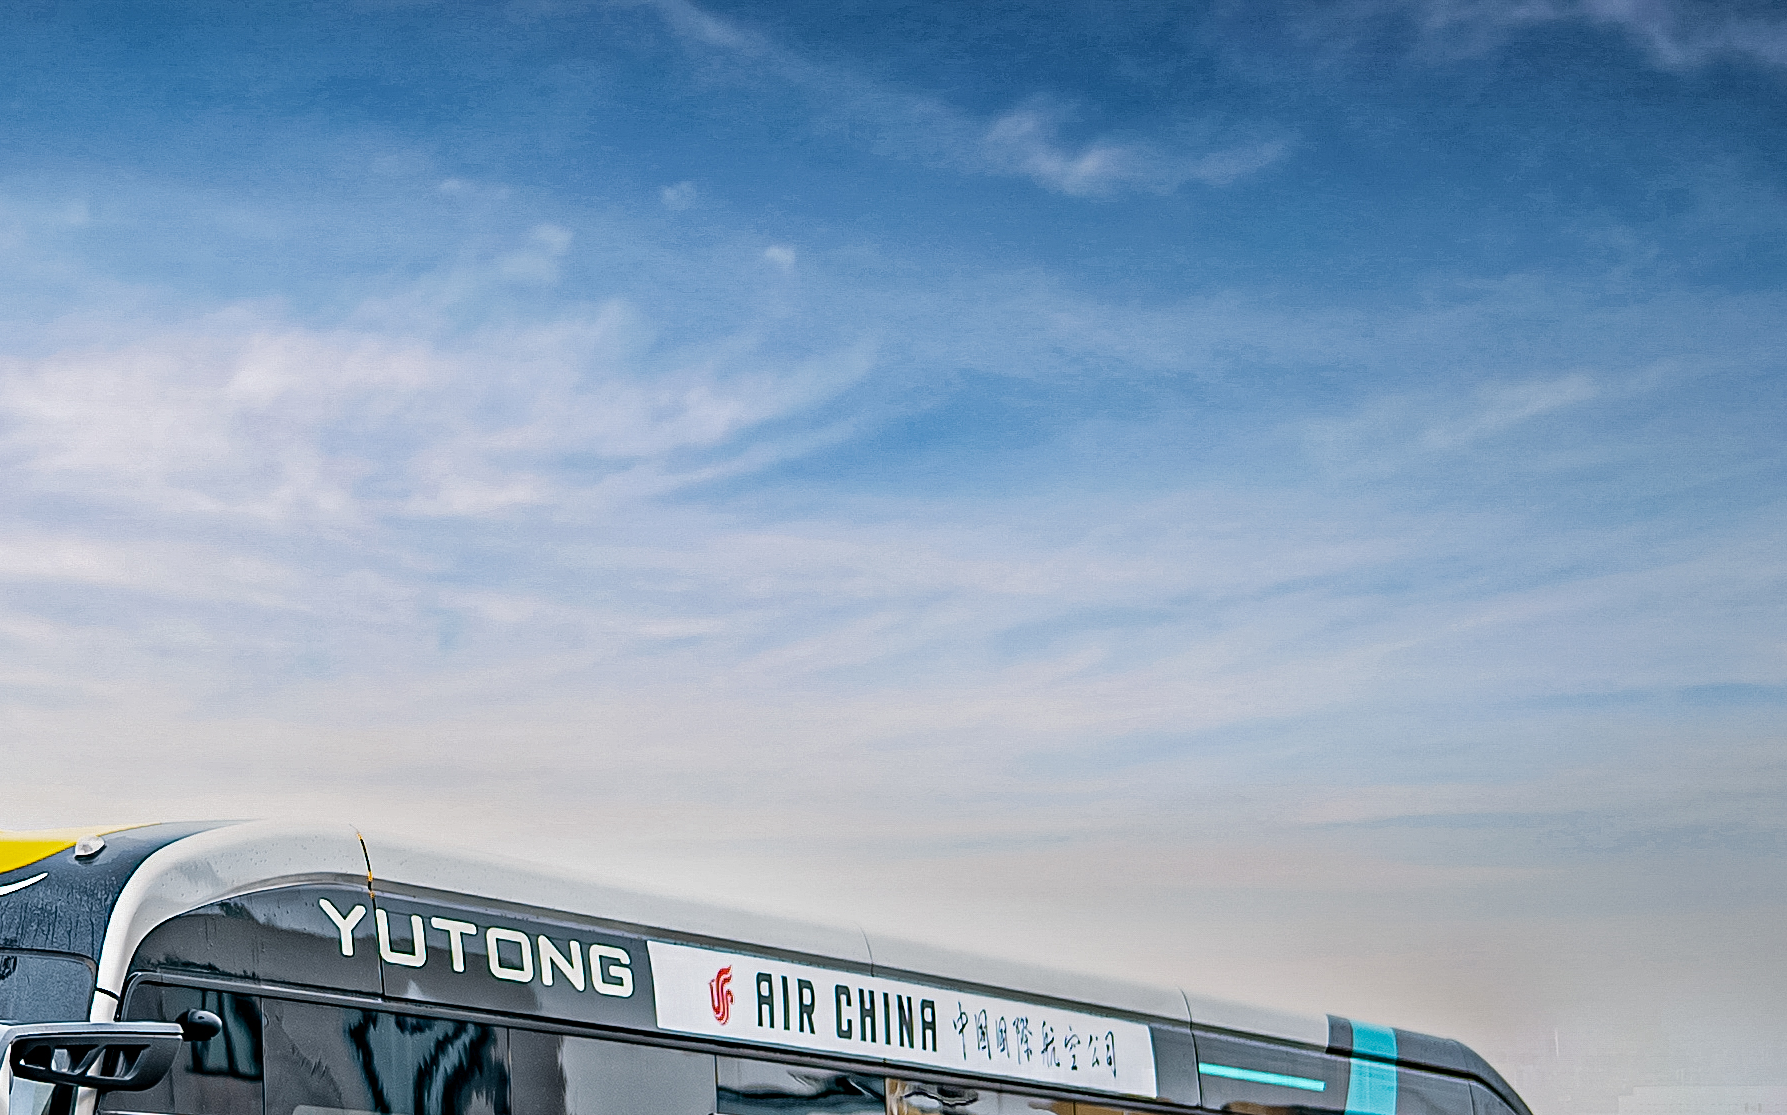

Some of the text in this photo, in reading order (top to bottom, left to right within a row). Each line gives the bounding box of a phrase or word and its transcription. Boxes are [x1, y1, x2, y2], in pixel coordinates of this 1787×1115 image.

[319, 898, 634, 999] YUTONG
[755, 971, 938, 1052] AIR CHINA
